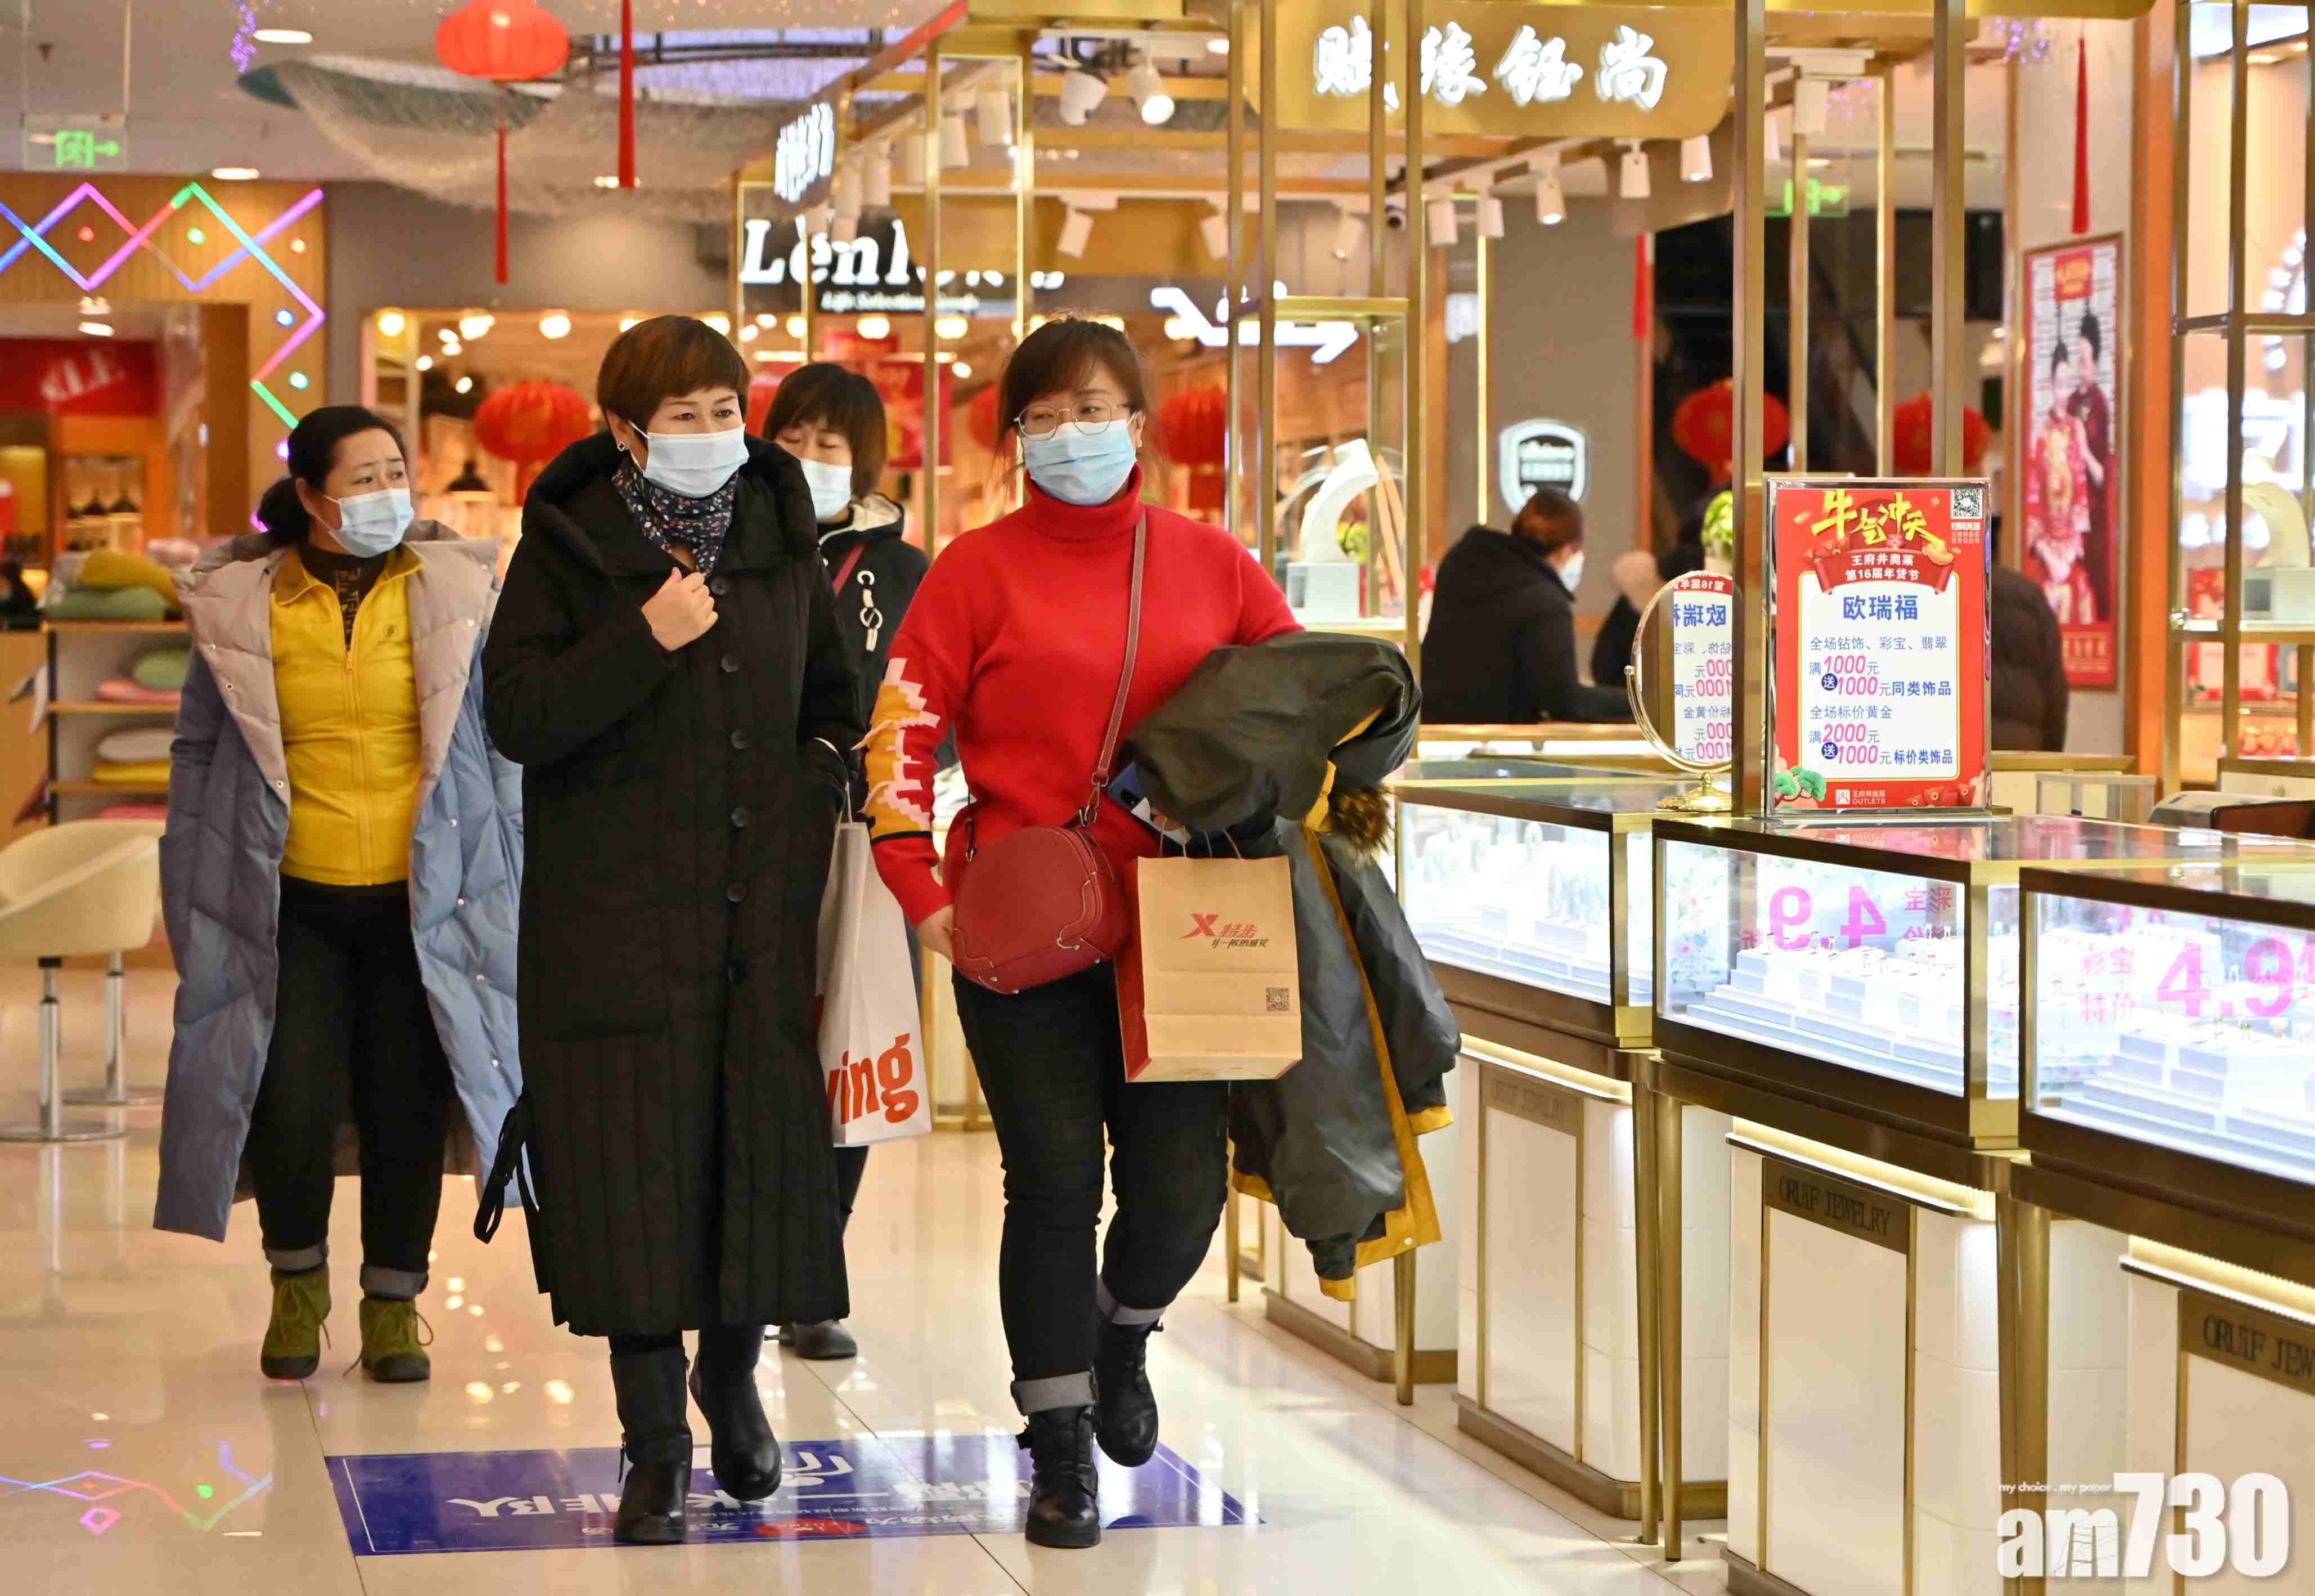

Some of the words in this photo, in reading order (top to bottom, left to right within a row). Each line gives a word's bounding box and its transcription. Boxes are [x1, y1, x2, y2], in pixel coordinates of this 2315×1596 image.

[1811, 488, 1946, 547] 牛气冲天
[1851, 553, 1914, 566] 王府井奥莱
[1846, 569, 1920, 581] 第16届年货节
[1843, 595, 1918, 621] 欧瑞福
[1810, 636, 1947, 651] 全场钻饰、彩宝、翡翠
[1809, 655, 1879, 675] 满1000元
[1810, 706, 1892, 720] 全场标价黄金
[1809, 724, 1879, 743] 满2000元
[2157, 938, 2294, 1017] 4.9
